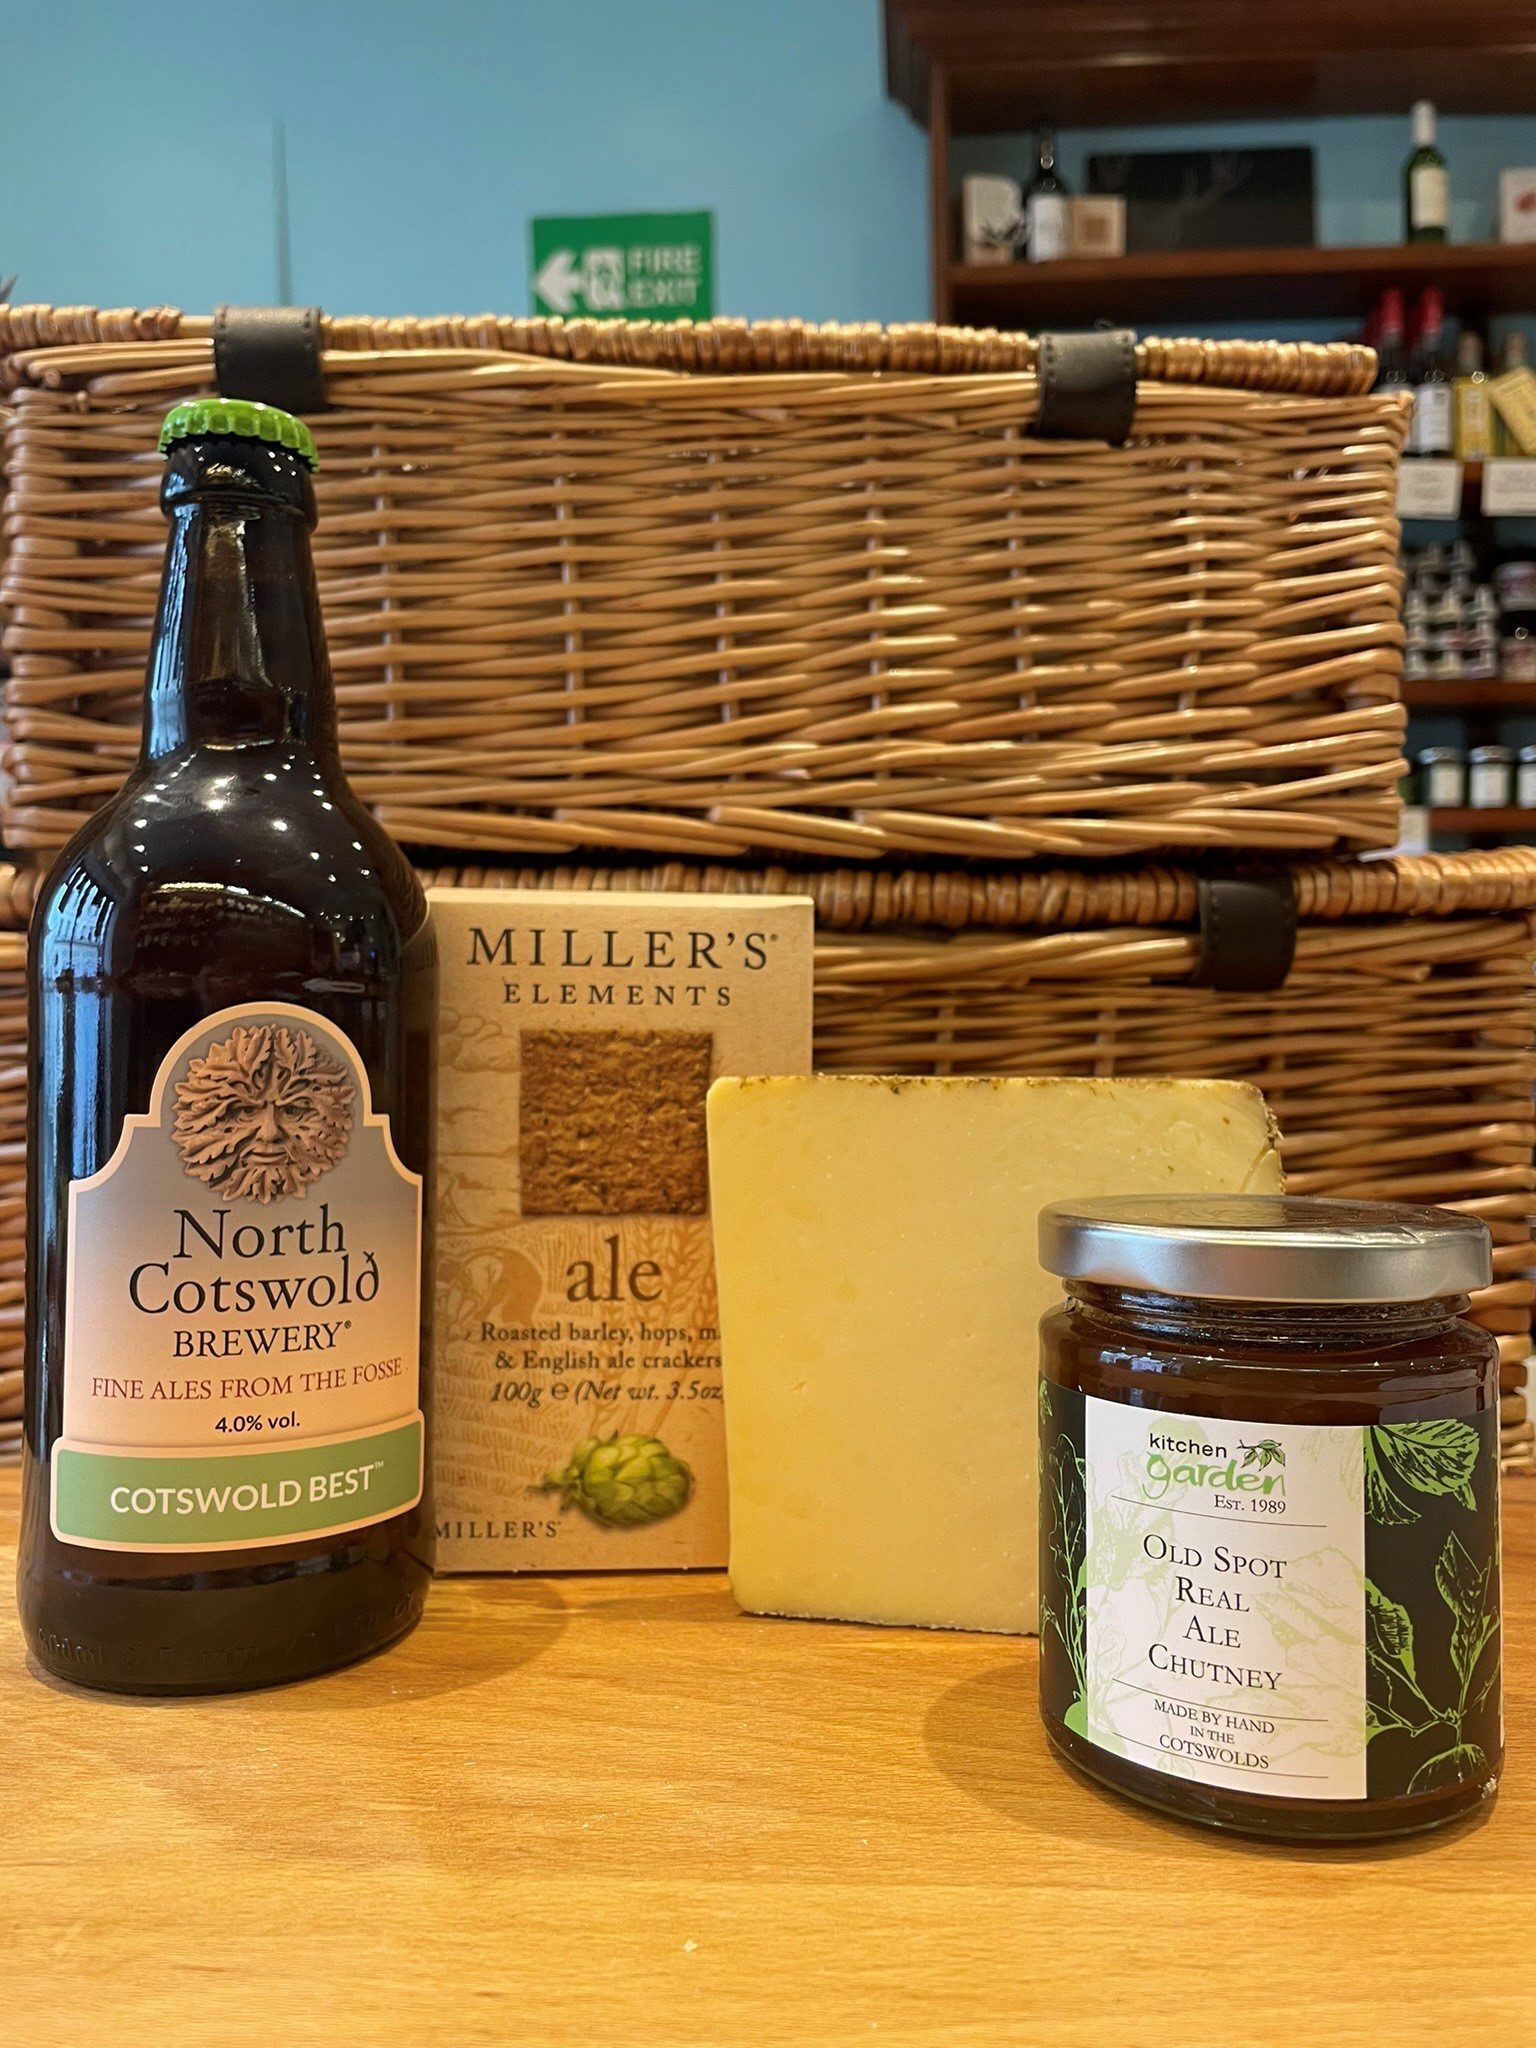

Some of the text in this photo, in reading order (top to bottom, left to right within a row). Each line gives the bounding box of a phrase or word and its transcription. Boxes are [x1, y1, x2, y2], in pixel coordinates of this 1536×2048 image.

[626, 245, 700, 274] FIRE
[627, 278, 698, 305] EXIT
[502, 982, 732, 1007] ELEMENTS
[172, 1203, 347, 1260] North
[129, 1251, 380, 1314] Cotswold
[565, 1234, 663, 1303] ale
[480, 1321, 722, 1346] Roasted barley, hops, m
[91, 1357, 403, 1401] FINE ALES FROM THE FOSSE
[495, 1350, 723, 1375] & English ale crackers
[490, 1380, 543, 1409] 100g
[574, 1379, 622, 1405] (Net
[627, 1384, 660, 1401] wt.
[214, 1410, 301, 1433] 4.0% vol.
[1148, 1433, 1227, 1459] kitchen
[1142, 1450, 1287, 1500] garden
[110, 1479, 301, 1516] COTSWOLD
[1250, 1498, 1287, 1514] 1989
[1143, 1533, 1288, 1579] OLD SPOT
[1174, 1576, 1250, 1613] REAL
[1182, 1615, 1242, 1649] ALE
[1148, 1643, 1283, 1691] CHUTNEY
[1154, 1699, 1275, 1734] MADE BY HAND
[1159, 1734, 1270, 1769] COTSWOLDS
[1190, 1725, 1235, 1744] IN THE
